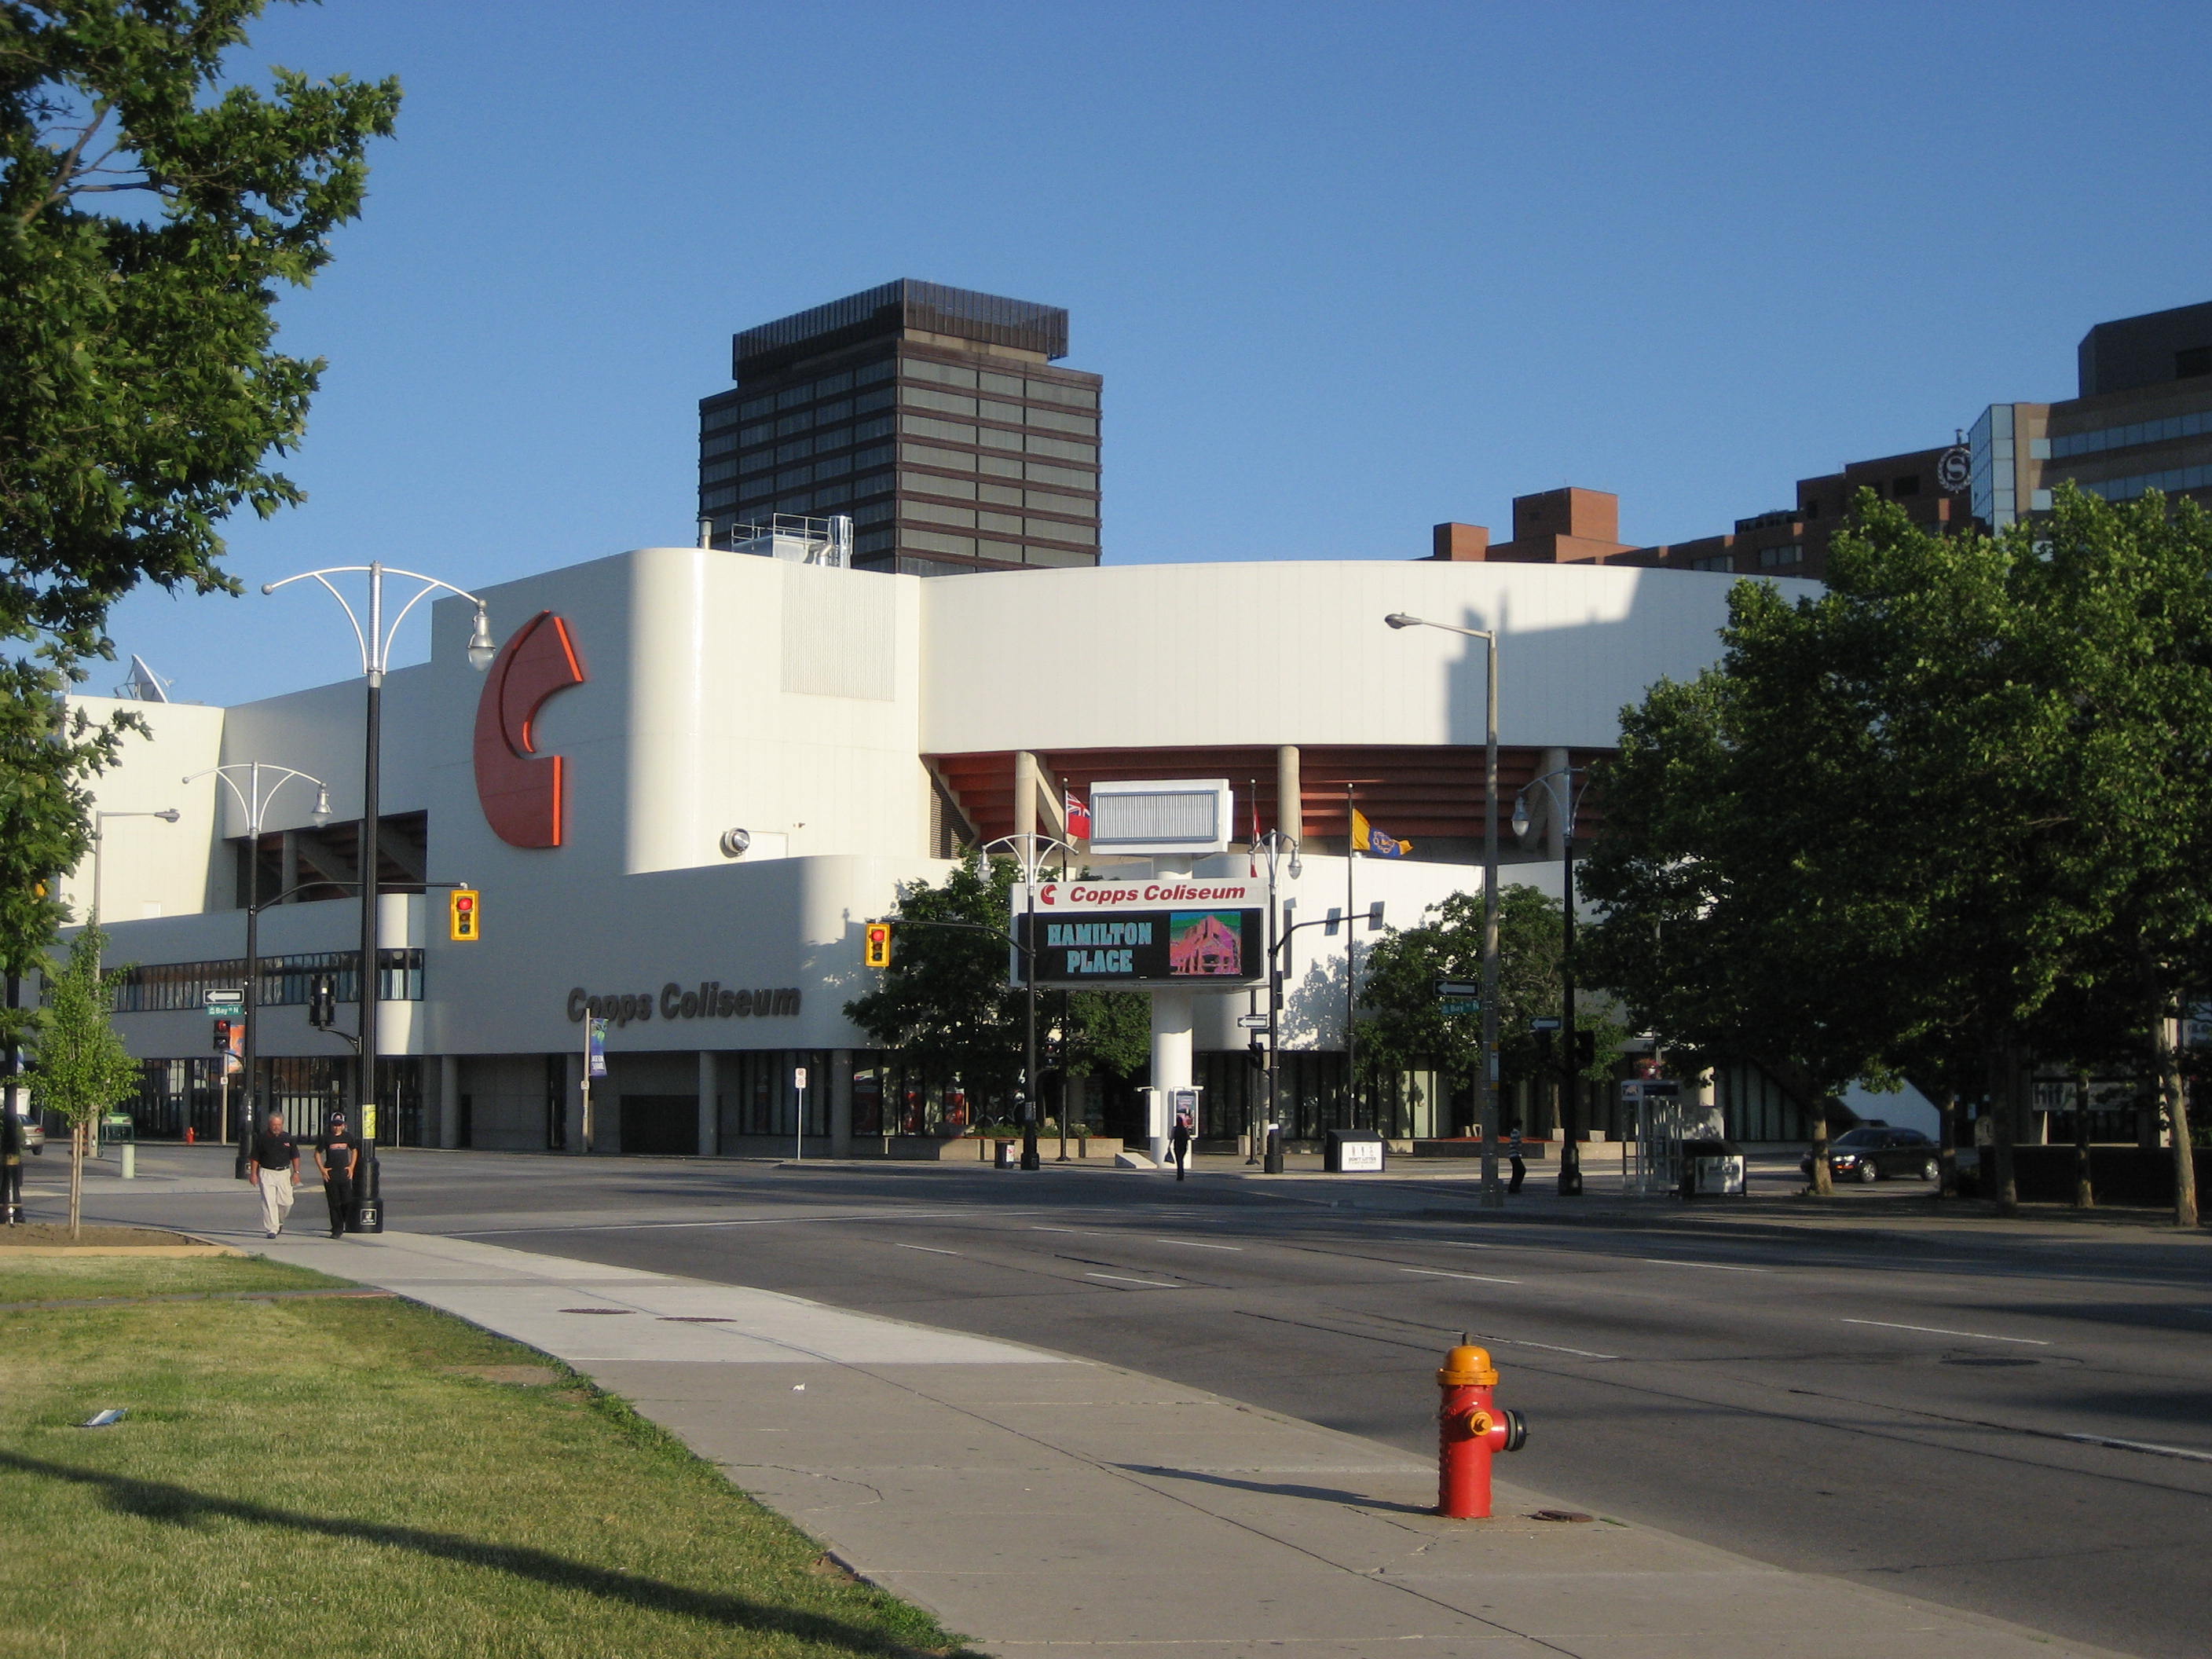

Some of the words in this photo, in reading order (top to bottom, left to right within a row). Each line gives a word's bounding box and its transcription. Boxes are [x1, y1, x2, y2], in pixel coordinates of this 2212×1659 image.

[1070, 886, 1138, 904] Copps
[1144, 885, 1245, 901] Coliseum
[1047, 922, 1152, 946] HAMILTON
[1067, 950, 1133, 973] PLACE
[567, 987, 653, 1028] Copps
[660, 982, 802, 1020] Coliseum
[1450, 1004, 1463, 1013] Bay
